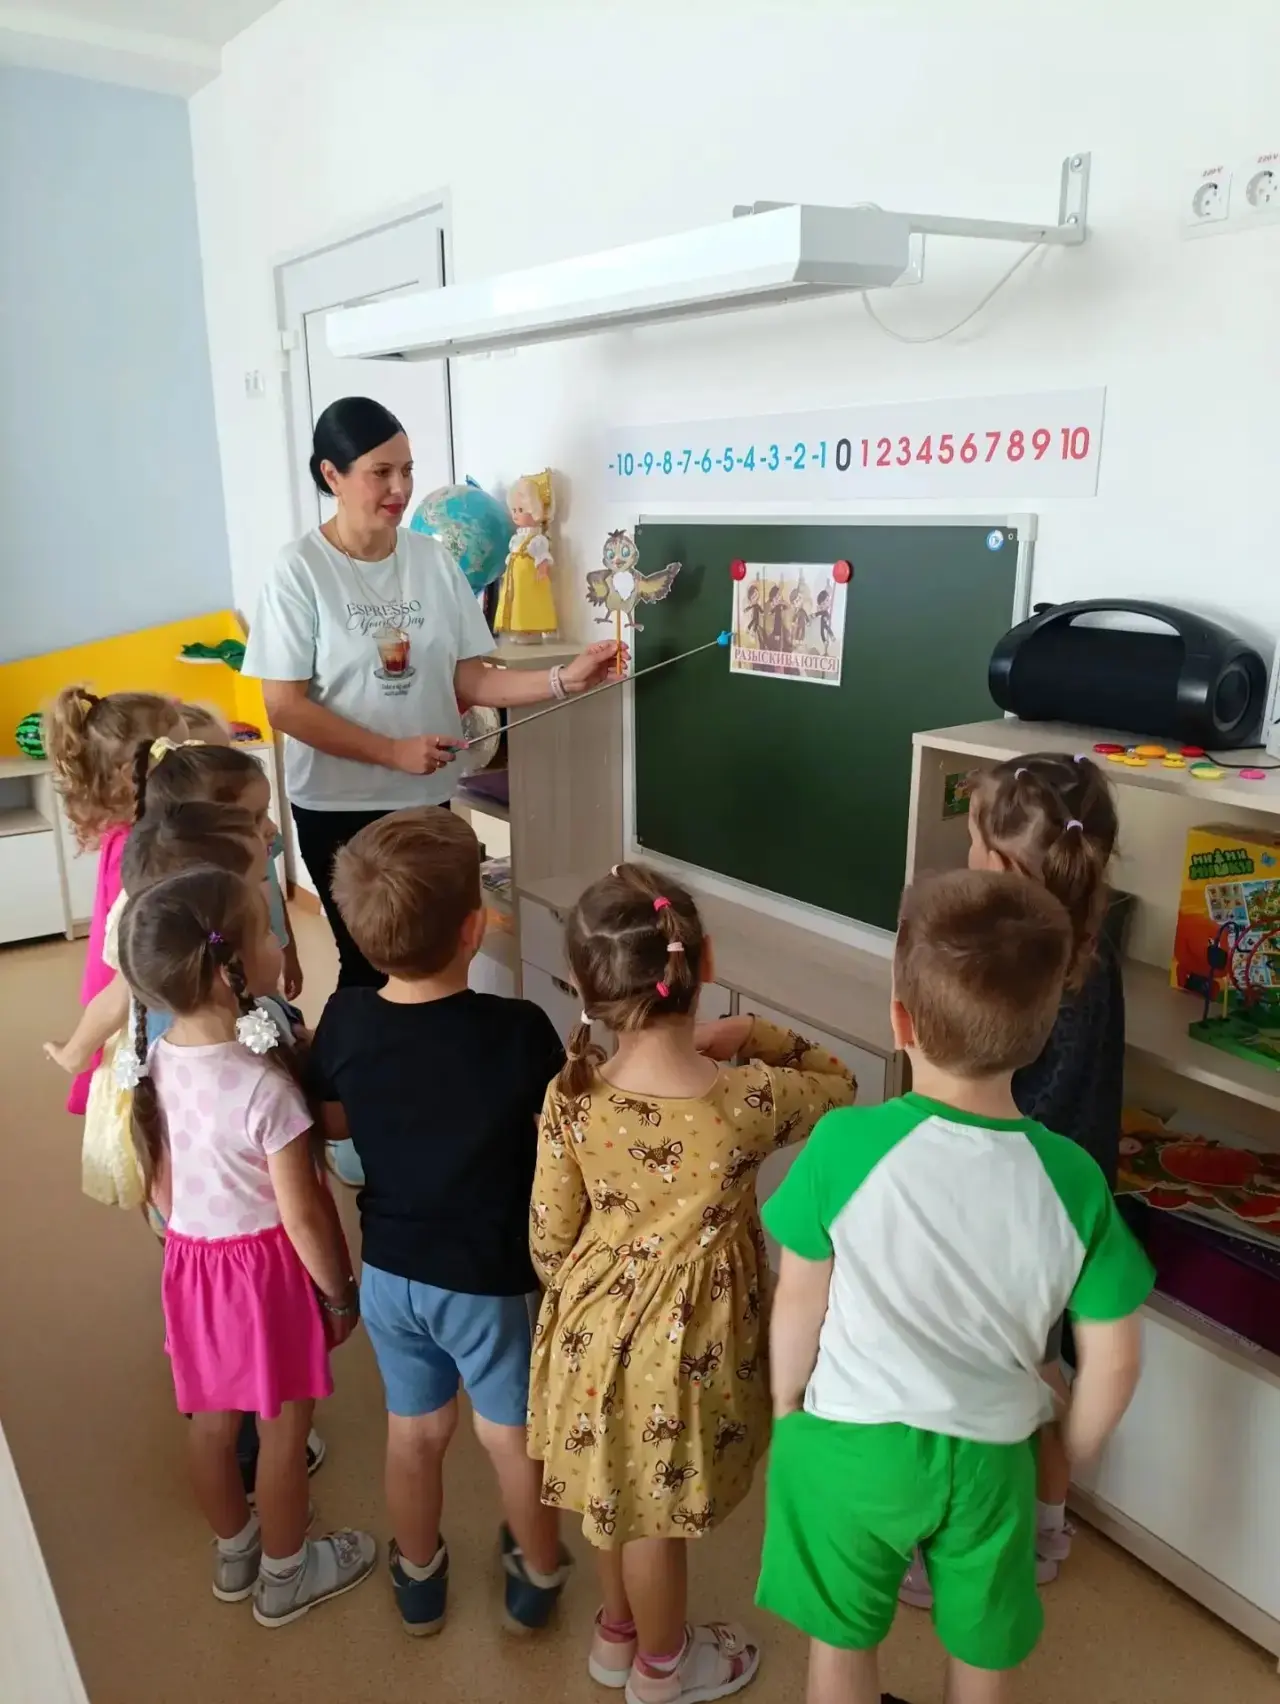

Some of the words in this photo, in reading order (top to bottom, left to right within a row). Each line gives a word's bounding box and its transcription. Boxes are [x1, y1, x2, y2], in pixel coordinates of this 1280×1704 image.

[609, 452, 634, 476] -10
[638, 452, 654, 475] -9
[656, 451, 673, 474] -8
[677, 450, 692, 474] -7
[694, 449, 712, 473] -6
[716, 447, 734, 472] -5
[736, 446, 755, 471] -4
[760, 444, 780, 471] -3
[785, 442, 806, 469] -2
[812, 441, 826, 468] -1
[835, 438, 852, 472] 0
[861, 439, 869, 467] 1
[876, 437, 892, 466] 2
[896, 436, 911, 466] 3
[916, 435, 933, 464] 4
[937, 434, 955, 464] 5
[960, 433, 978, 464] 6
[985, 431, 1001, 462] 7
[1006, 430, 1025, 462] 8
[1031, 428, 1051, 460] 9
[1060, 426, 1090, 460] 10
[346, 600, 422, 617] ESPRESSO
